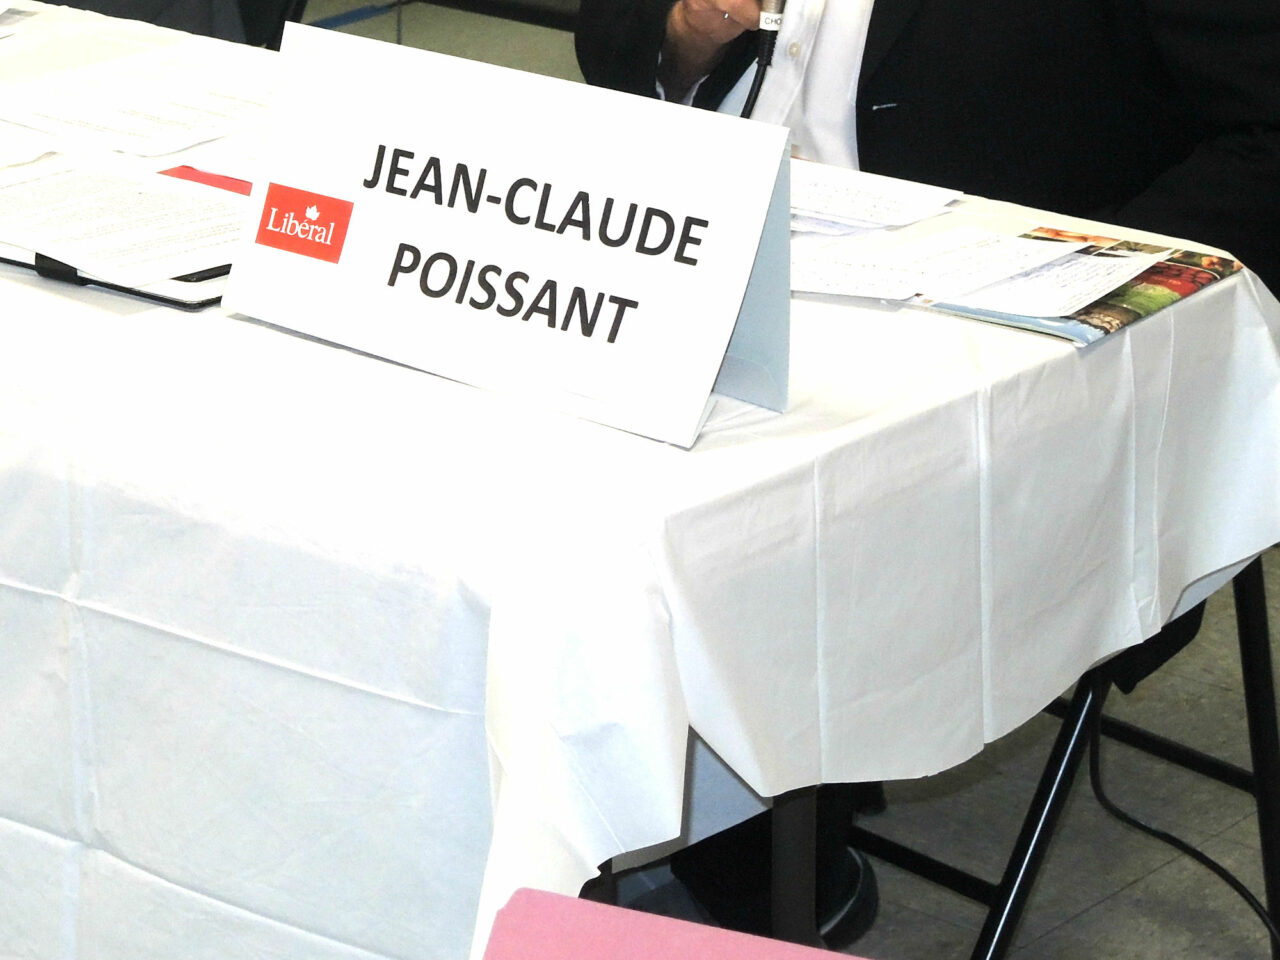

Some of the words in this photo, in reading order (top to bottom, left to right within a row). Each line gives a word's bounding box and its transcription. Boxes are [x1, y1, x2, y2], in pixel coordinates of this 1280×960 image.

[266, 207, 335, 246] Libéral
[363, 144, 709, 266] JEAN-CLAUDE
[387, 243, 639, 344] POISSANT
